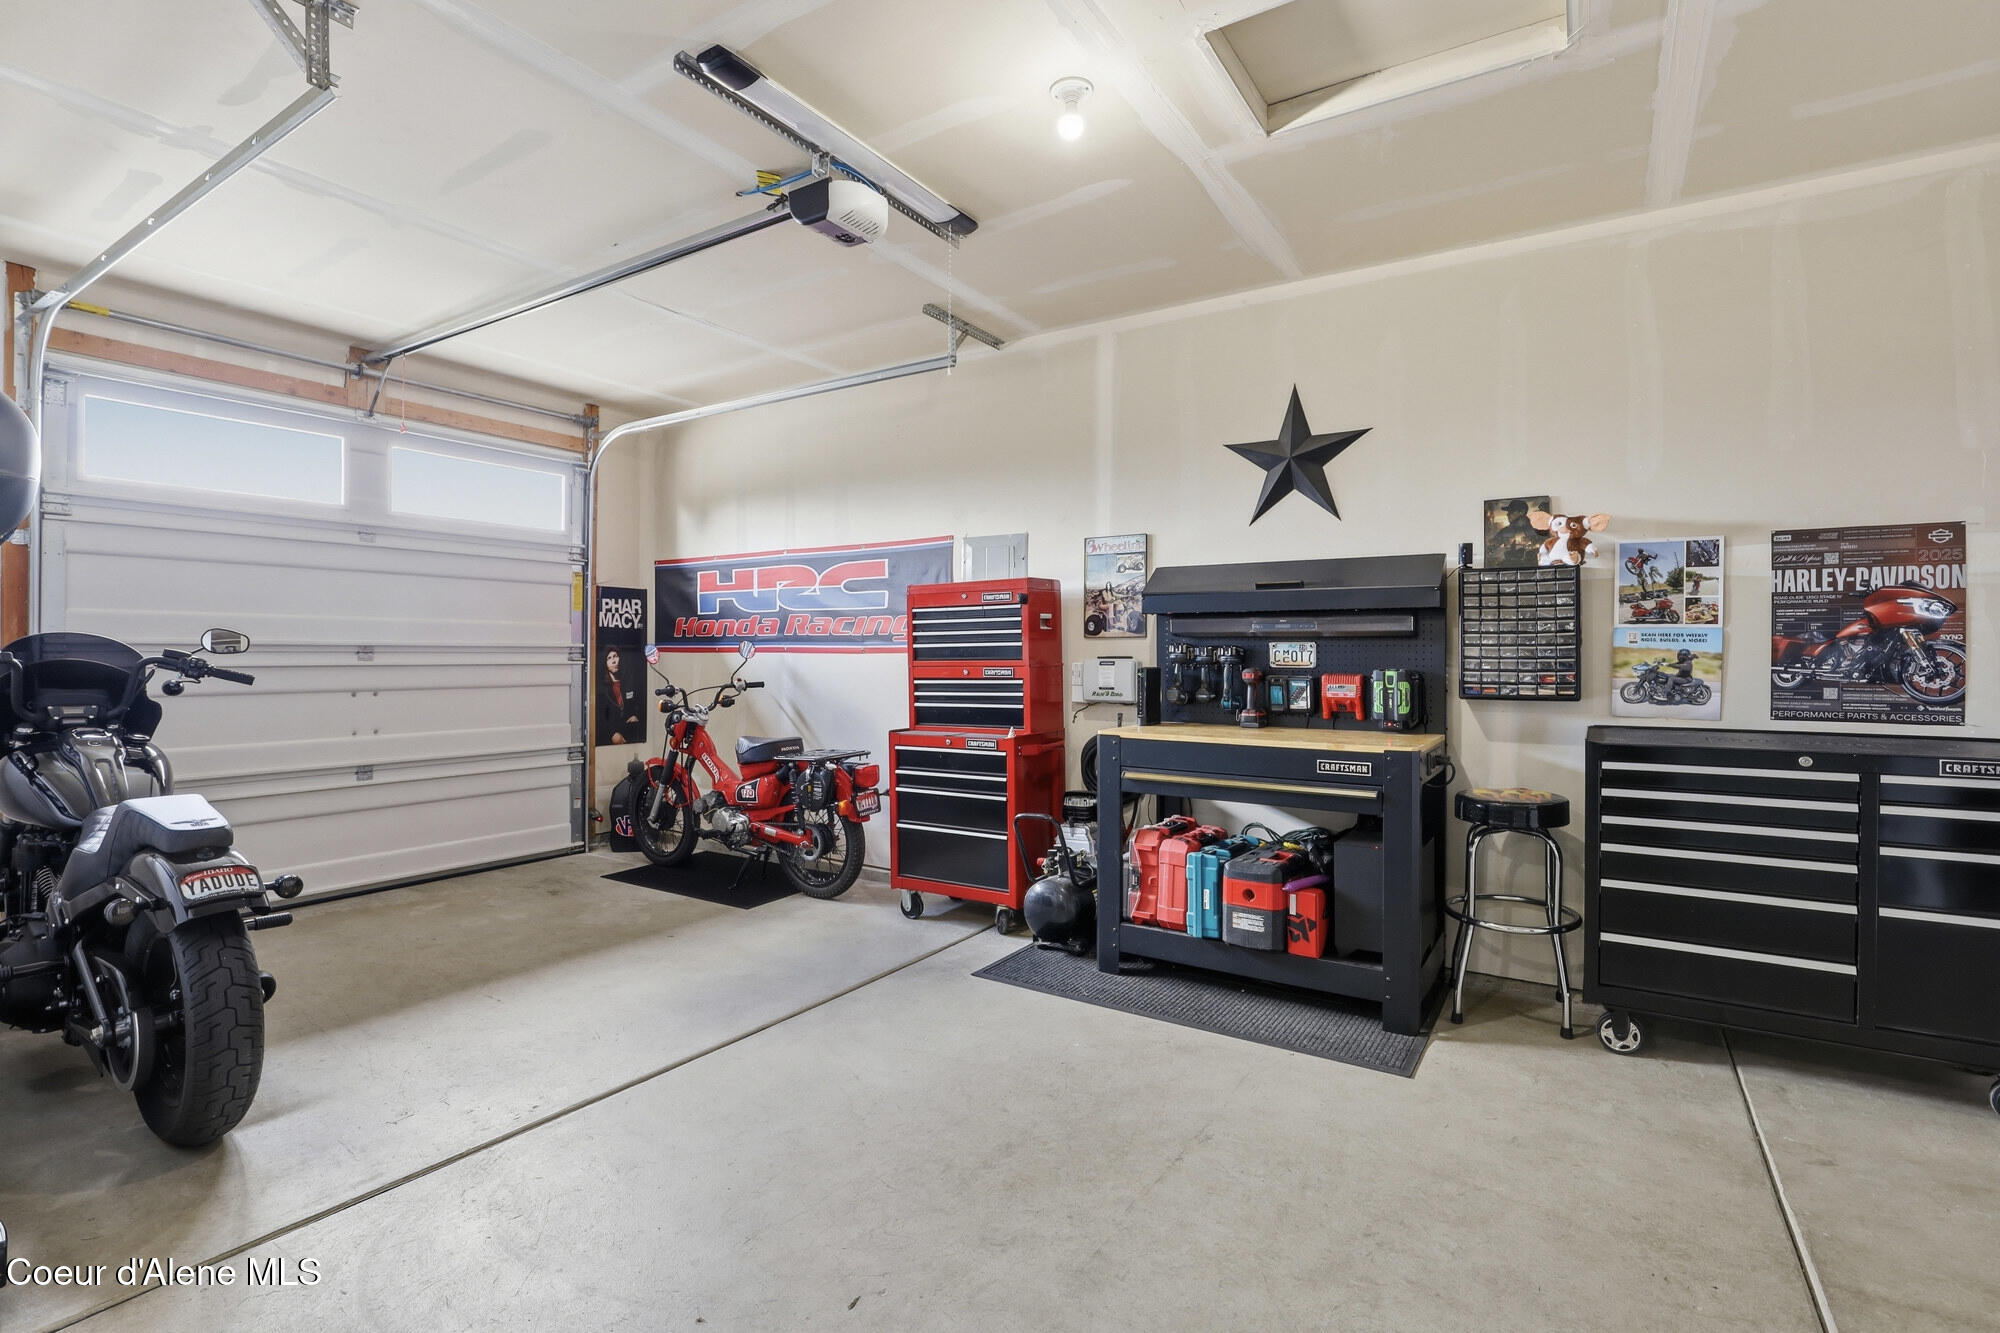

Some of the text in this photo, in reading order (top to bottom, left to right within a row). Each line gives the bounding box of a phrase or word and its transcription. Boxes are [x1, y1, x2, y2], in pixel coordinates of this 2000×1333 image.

[1919, 549, 1963, 562] 2025
[1771, 563, 1967, 592] HARLEY-DAVIDSON
[697, 559, 889, 615] HRC
[602, 598, 642, 614] PHAR
[599, 611, 642, 629] MACY
[674, 614, 909, 641] Honda Racing
[1773, 711, 1844, 719] PERFORMANCE
[1847, 712, 1879, 720] PARTS
[1889, 714, 1962, 723] ACCESSORIES
[1320, 763, 1368, 773] CRAFTSMAN
[203, 867, 234, 875] IDAHO
[185, 873, 258, 895] YADUDE
